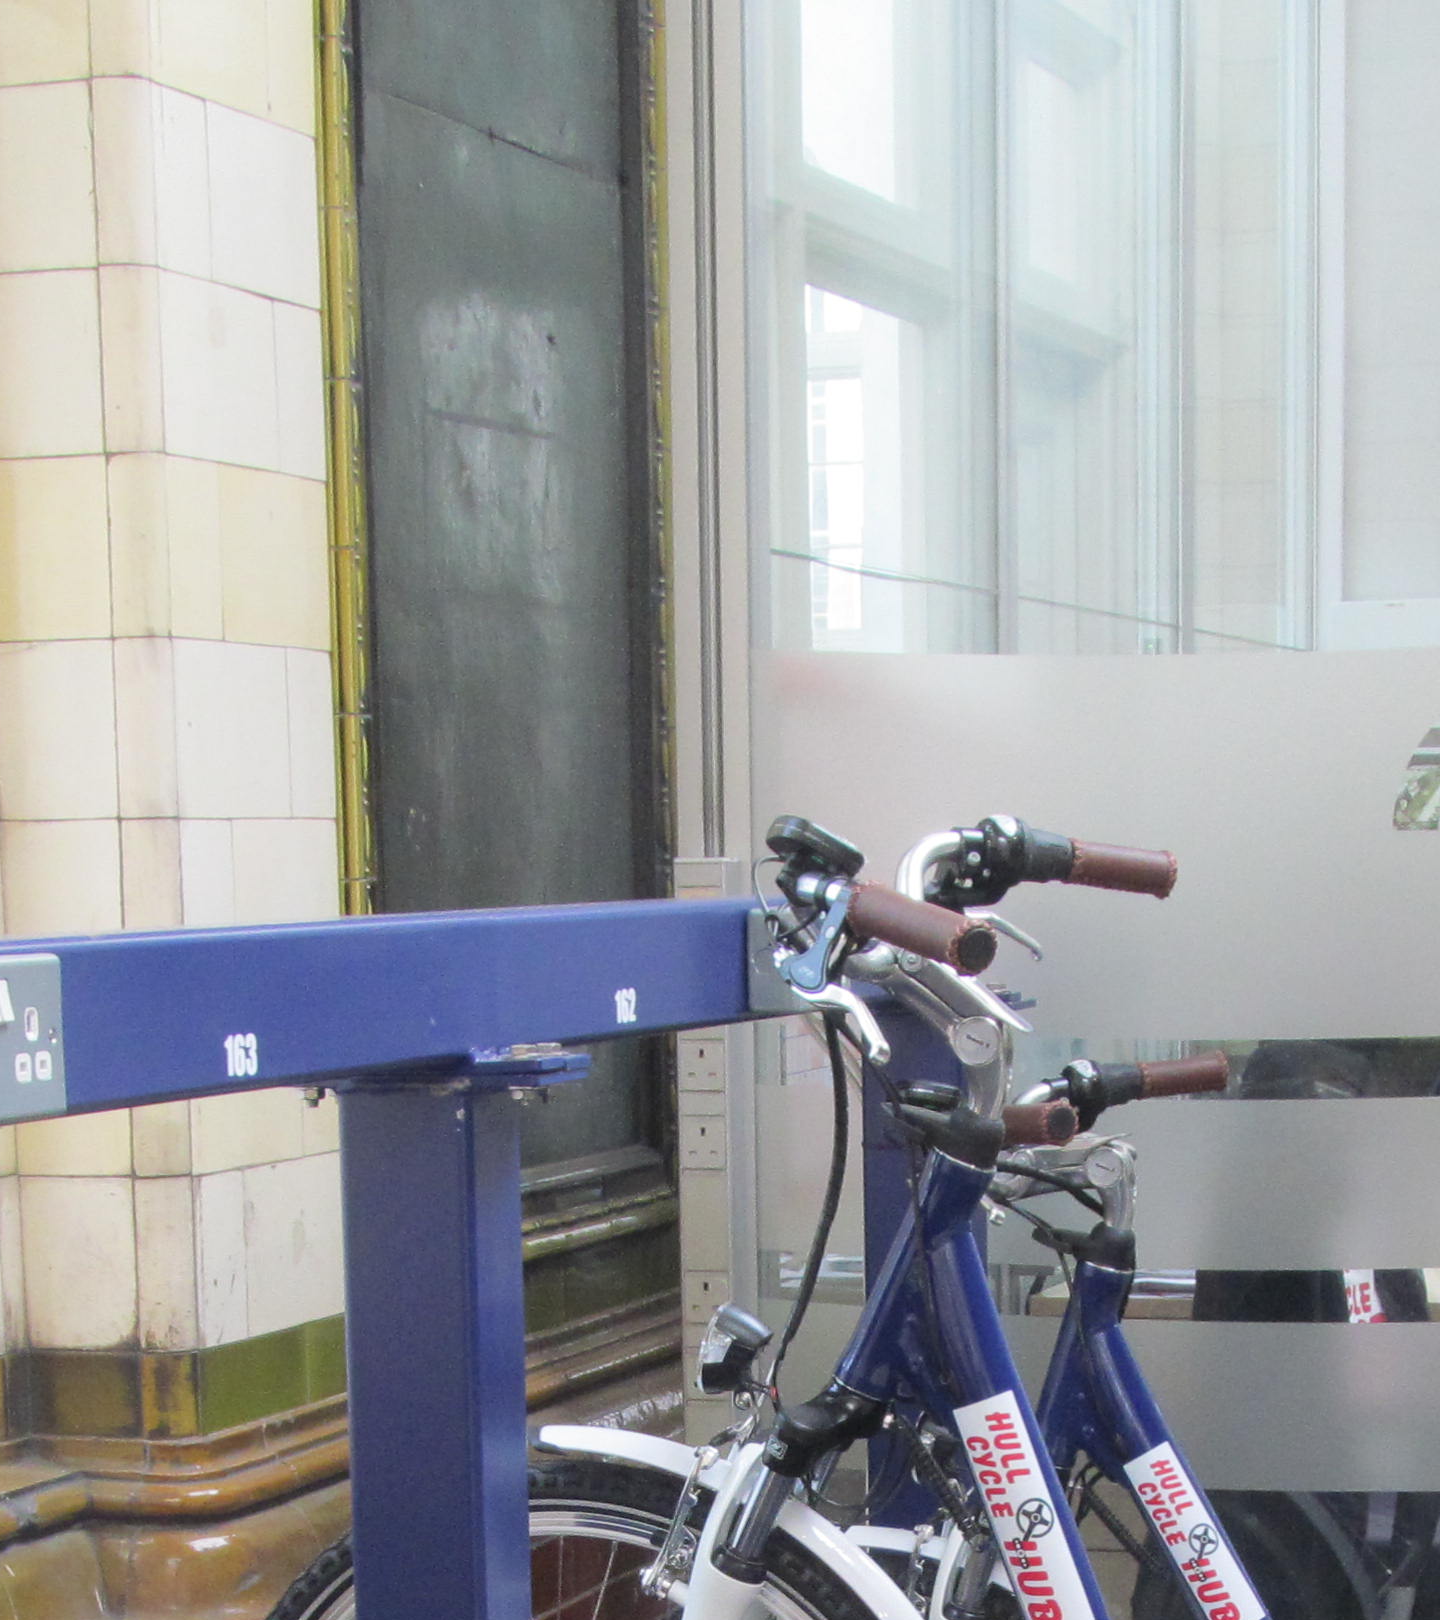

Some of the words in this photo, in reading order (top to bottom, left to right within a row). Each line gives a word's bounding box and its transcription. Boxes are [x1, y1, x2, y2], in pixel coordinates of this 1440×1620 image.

[614, 987, 637, 1024] 162
[223, 1032, 258, 1077] 163
[1344, 1282, 1371, 1316] CLE
[985, 1411, 1031, 1484] HULL
[966, 1436, 1014, 1519] CYCLE
[1150, 1459, 1194, 1516] HULL
[1137, 1482, 1187, 1547] CYCLE
